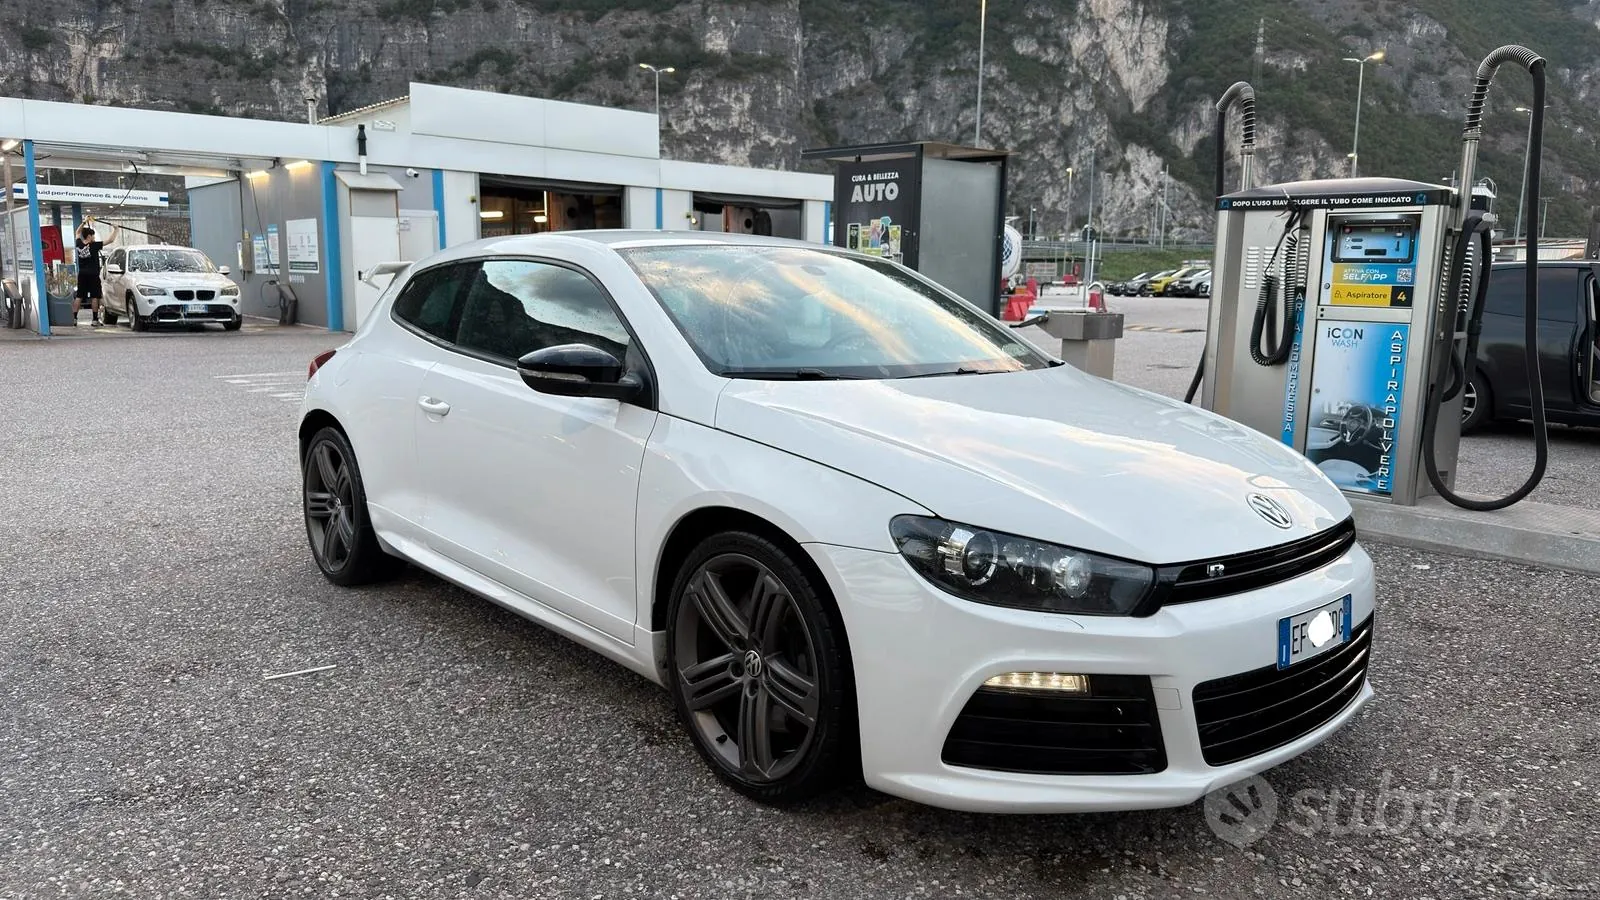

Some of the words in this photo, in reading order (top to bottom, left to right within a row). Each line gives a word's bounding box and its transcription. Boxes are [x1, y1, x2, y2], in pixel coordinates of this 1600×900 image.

[852, 174, 866, 182] CURA
[873, 171, 899, 180] BELLEZZA
[851, 182, 899, 202] AUTO
[1272, 198, 1319, 206] RIAVLGERE
[1375, 196, 1412, 204] INDICATO
[1346, 291, 1388, 301] Aspiratore
[1397, 291, 1407, 302] 4
[1294, 292, 1304, 333] ARIA
[1331, 340, 1358, 348] WASH
[1284, 342, 1300, 432] COMPRESSA
[1377, 330, 1403, 490] ASPIRAPOLVERE
[1206, 563, 1225, 578] R
